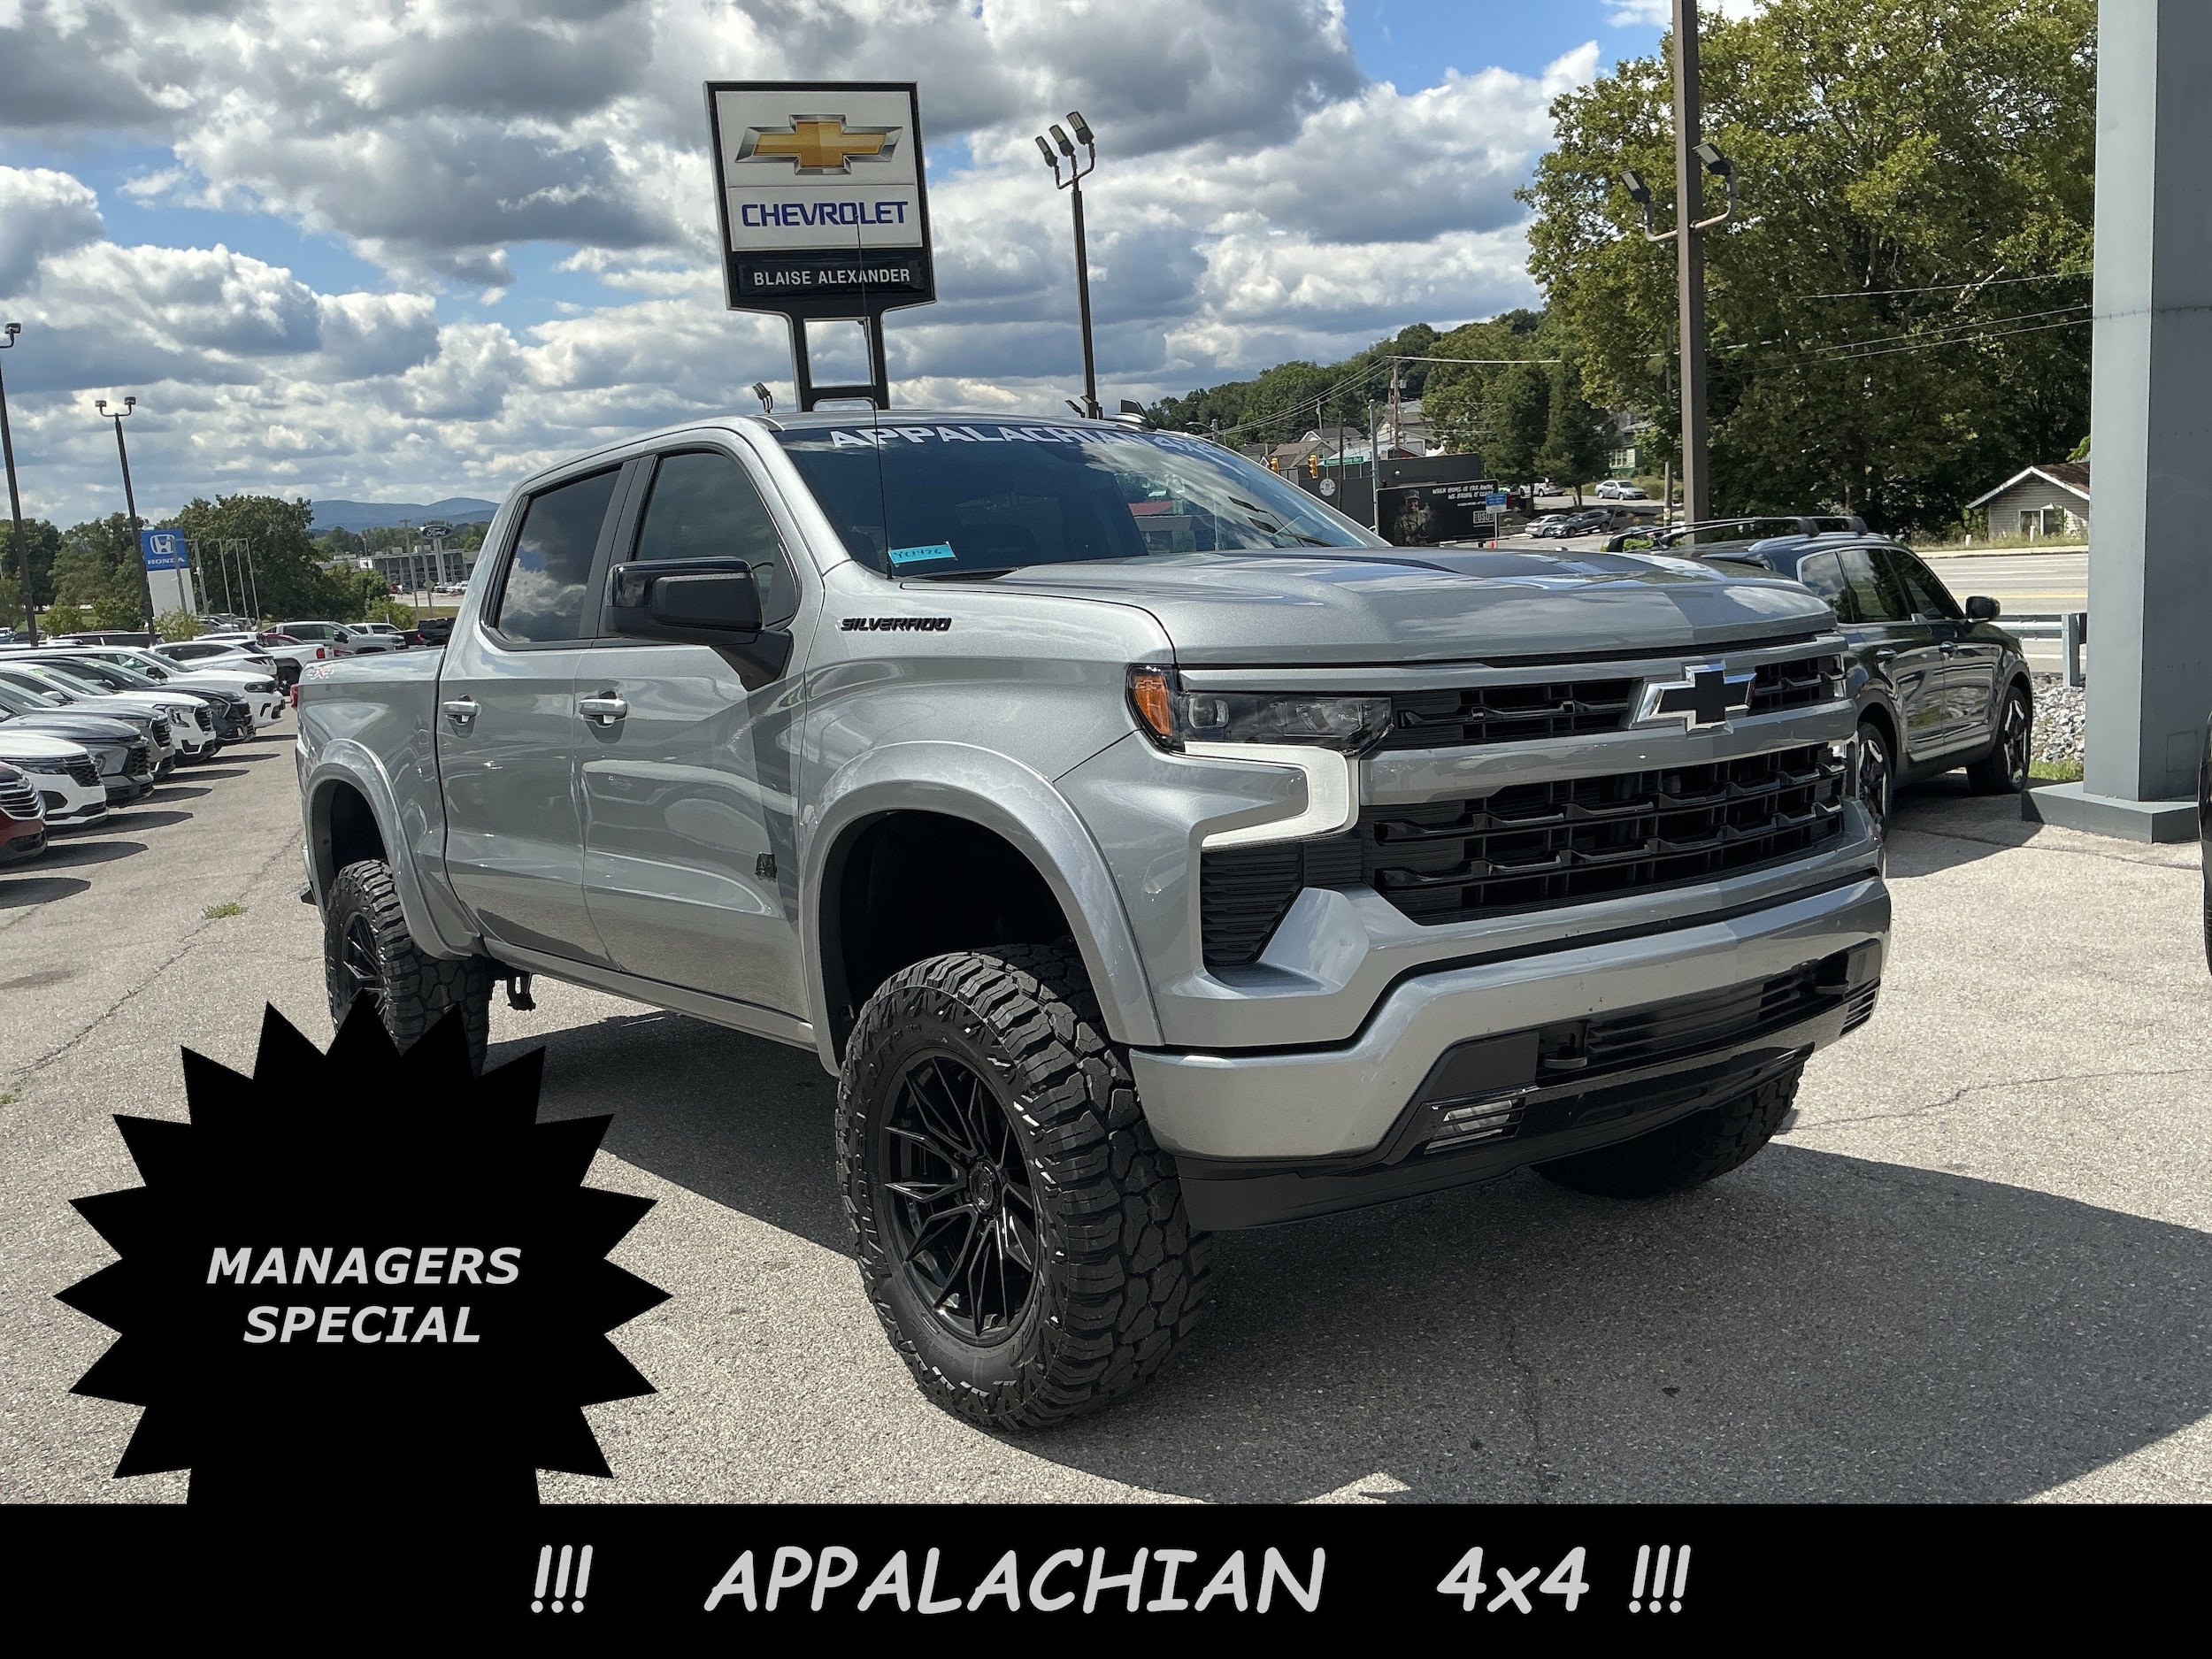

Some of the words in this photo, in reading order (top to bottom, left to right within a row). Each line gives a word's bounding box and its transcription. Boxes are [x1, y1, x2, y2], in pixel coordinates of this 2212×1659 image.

[741, 202, 909, 227] CHEVROLET
[753, 271, 812, 286] BLAISE
[818, 268, 910, 284] ALEXANDER
[830, 426, 1157, 448] APPALACHIAN
[1477, 512, 1490, 521] USO
[426, 527, 446, 536] Ford
[841, 618, 952, 632] SILVERADO
[307, 666, 334, 680] 4X4
